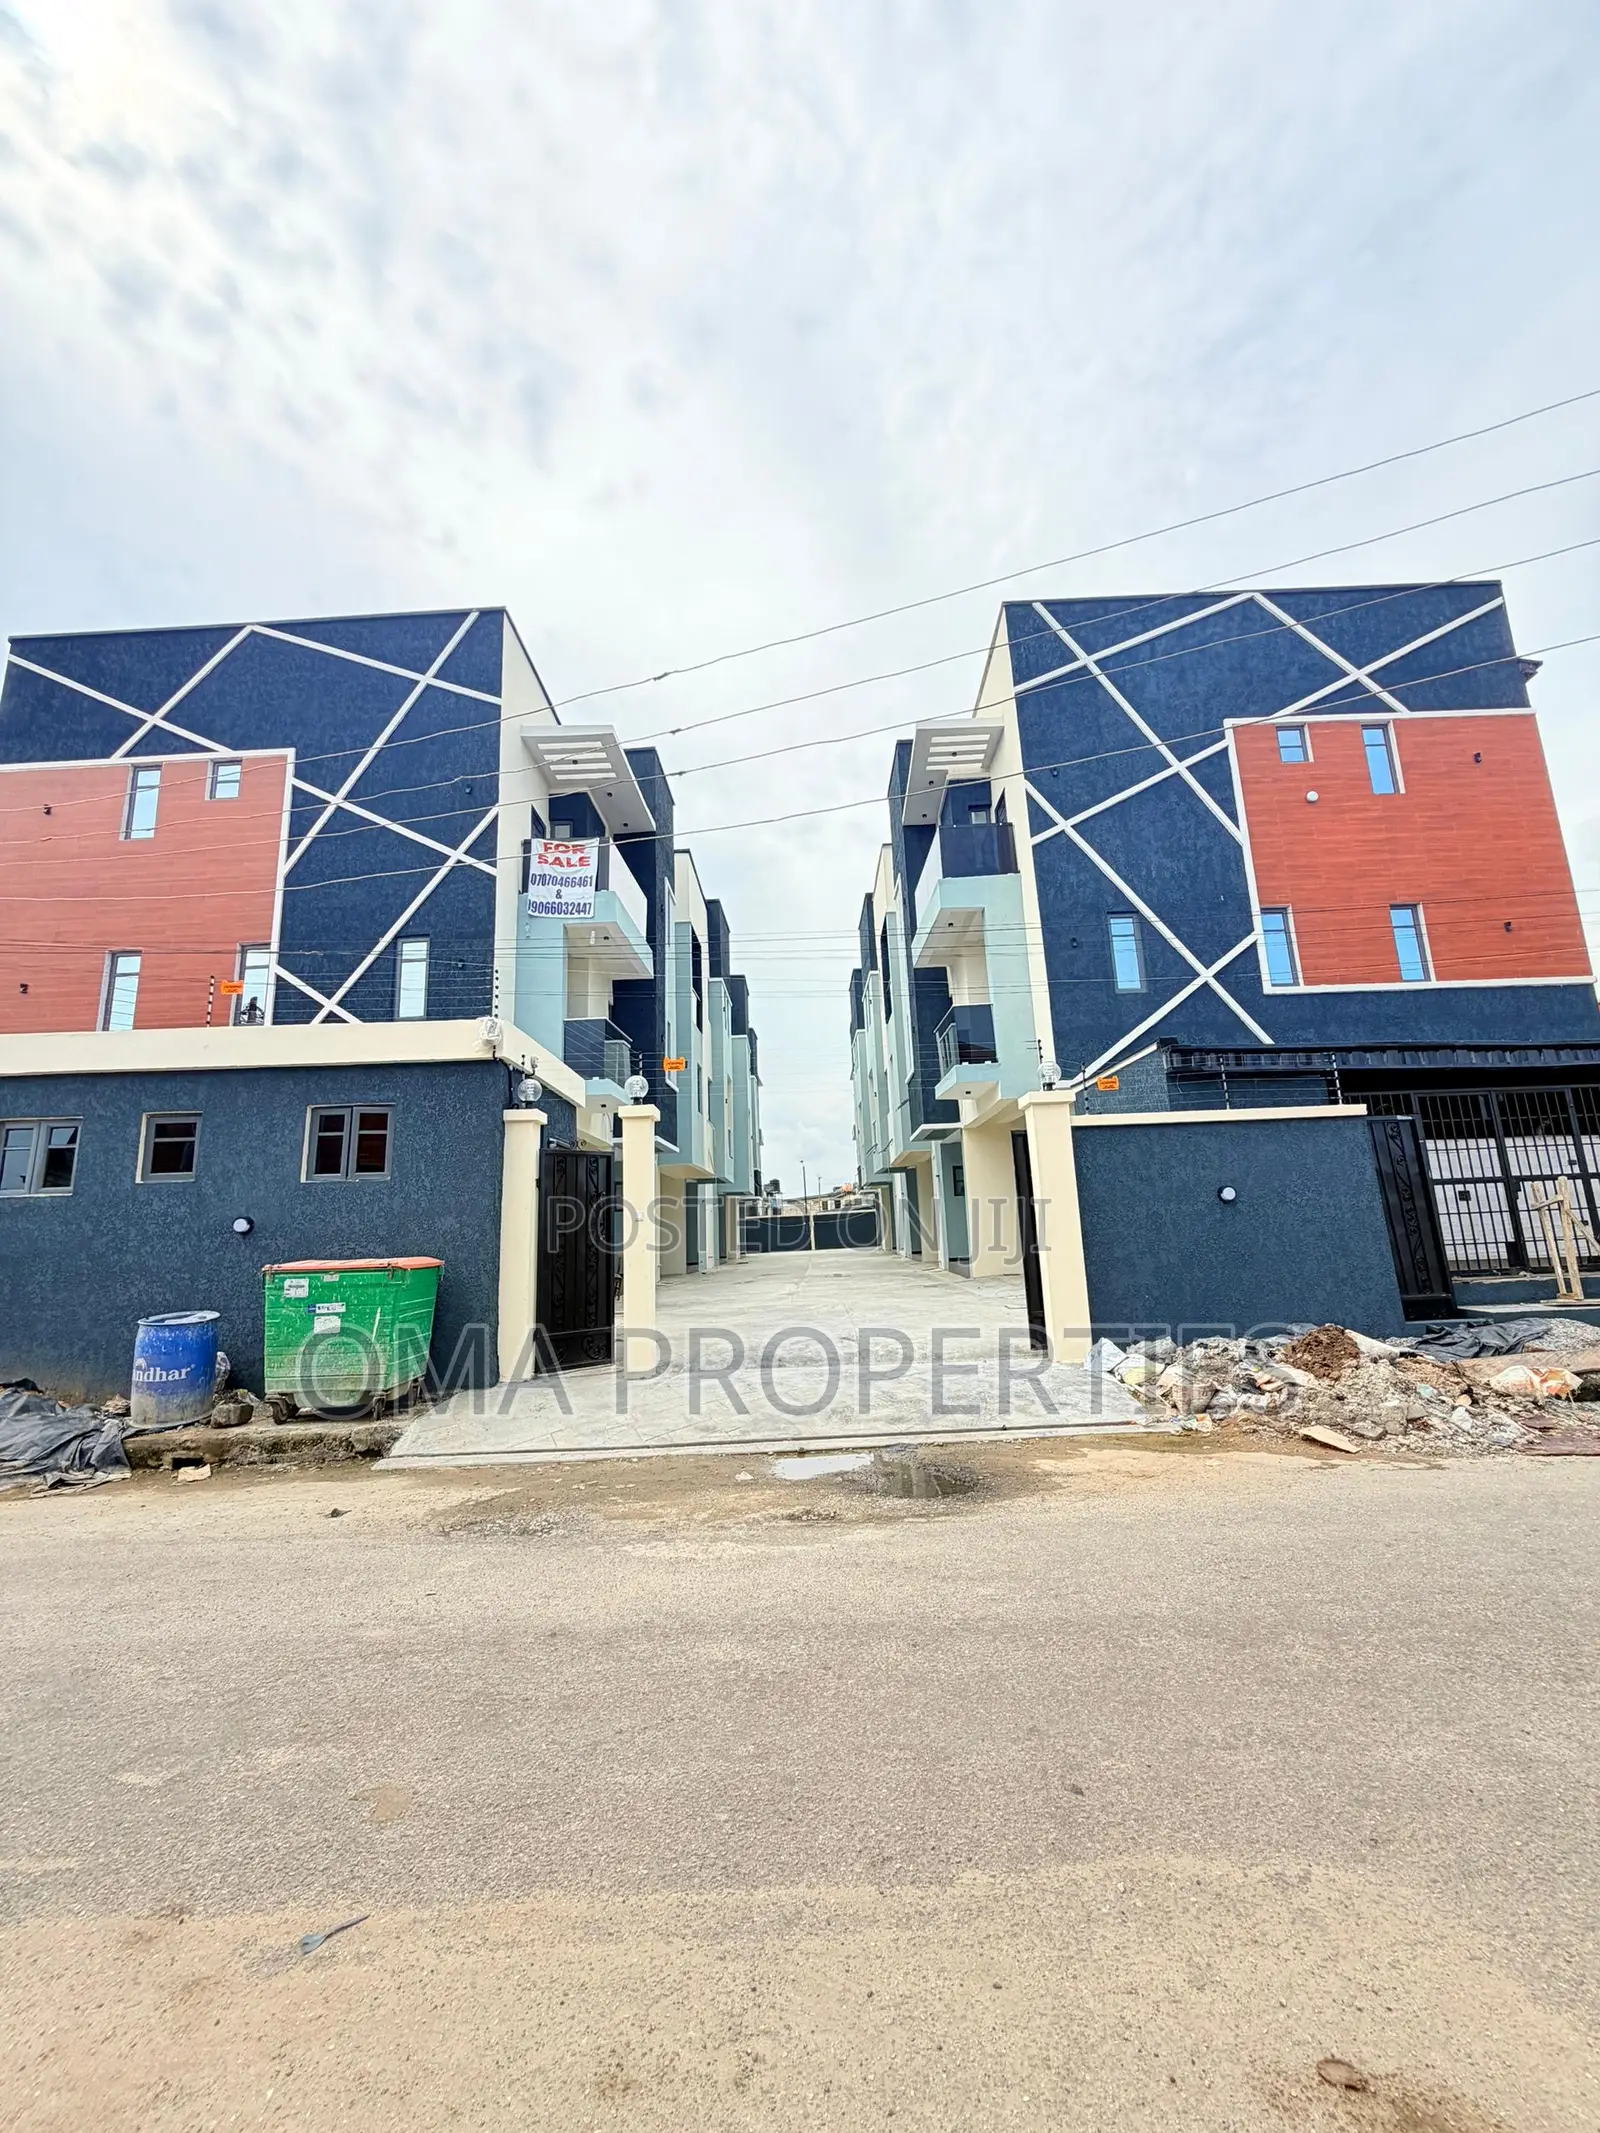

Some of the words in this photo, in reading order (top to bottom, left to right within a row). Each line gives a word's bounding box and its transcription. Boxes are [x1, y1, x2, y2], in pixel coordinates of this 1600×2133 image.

[542, 841, 586, 854] FOR
[537, 853, 591, 868] SALE
[530, 873, 593, 888] 07070466461
[555, 889, 562, 900] &
